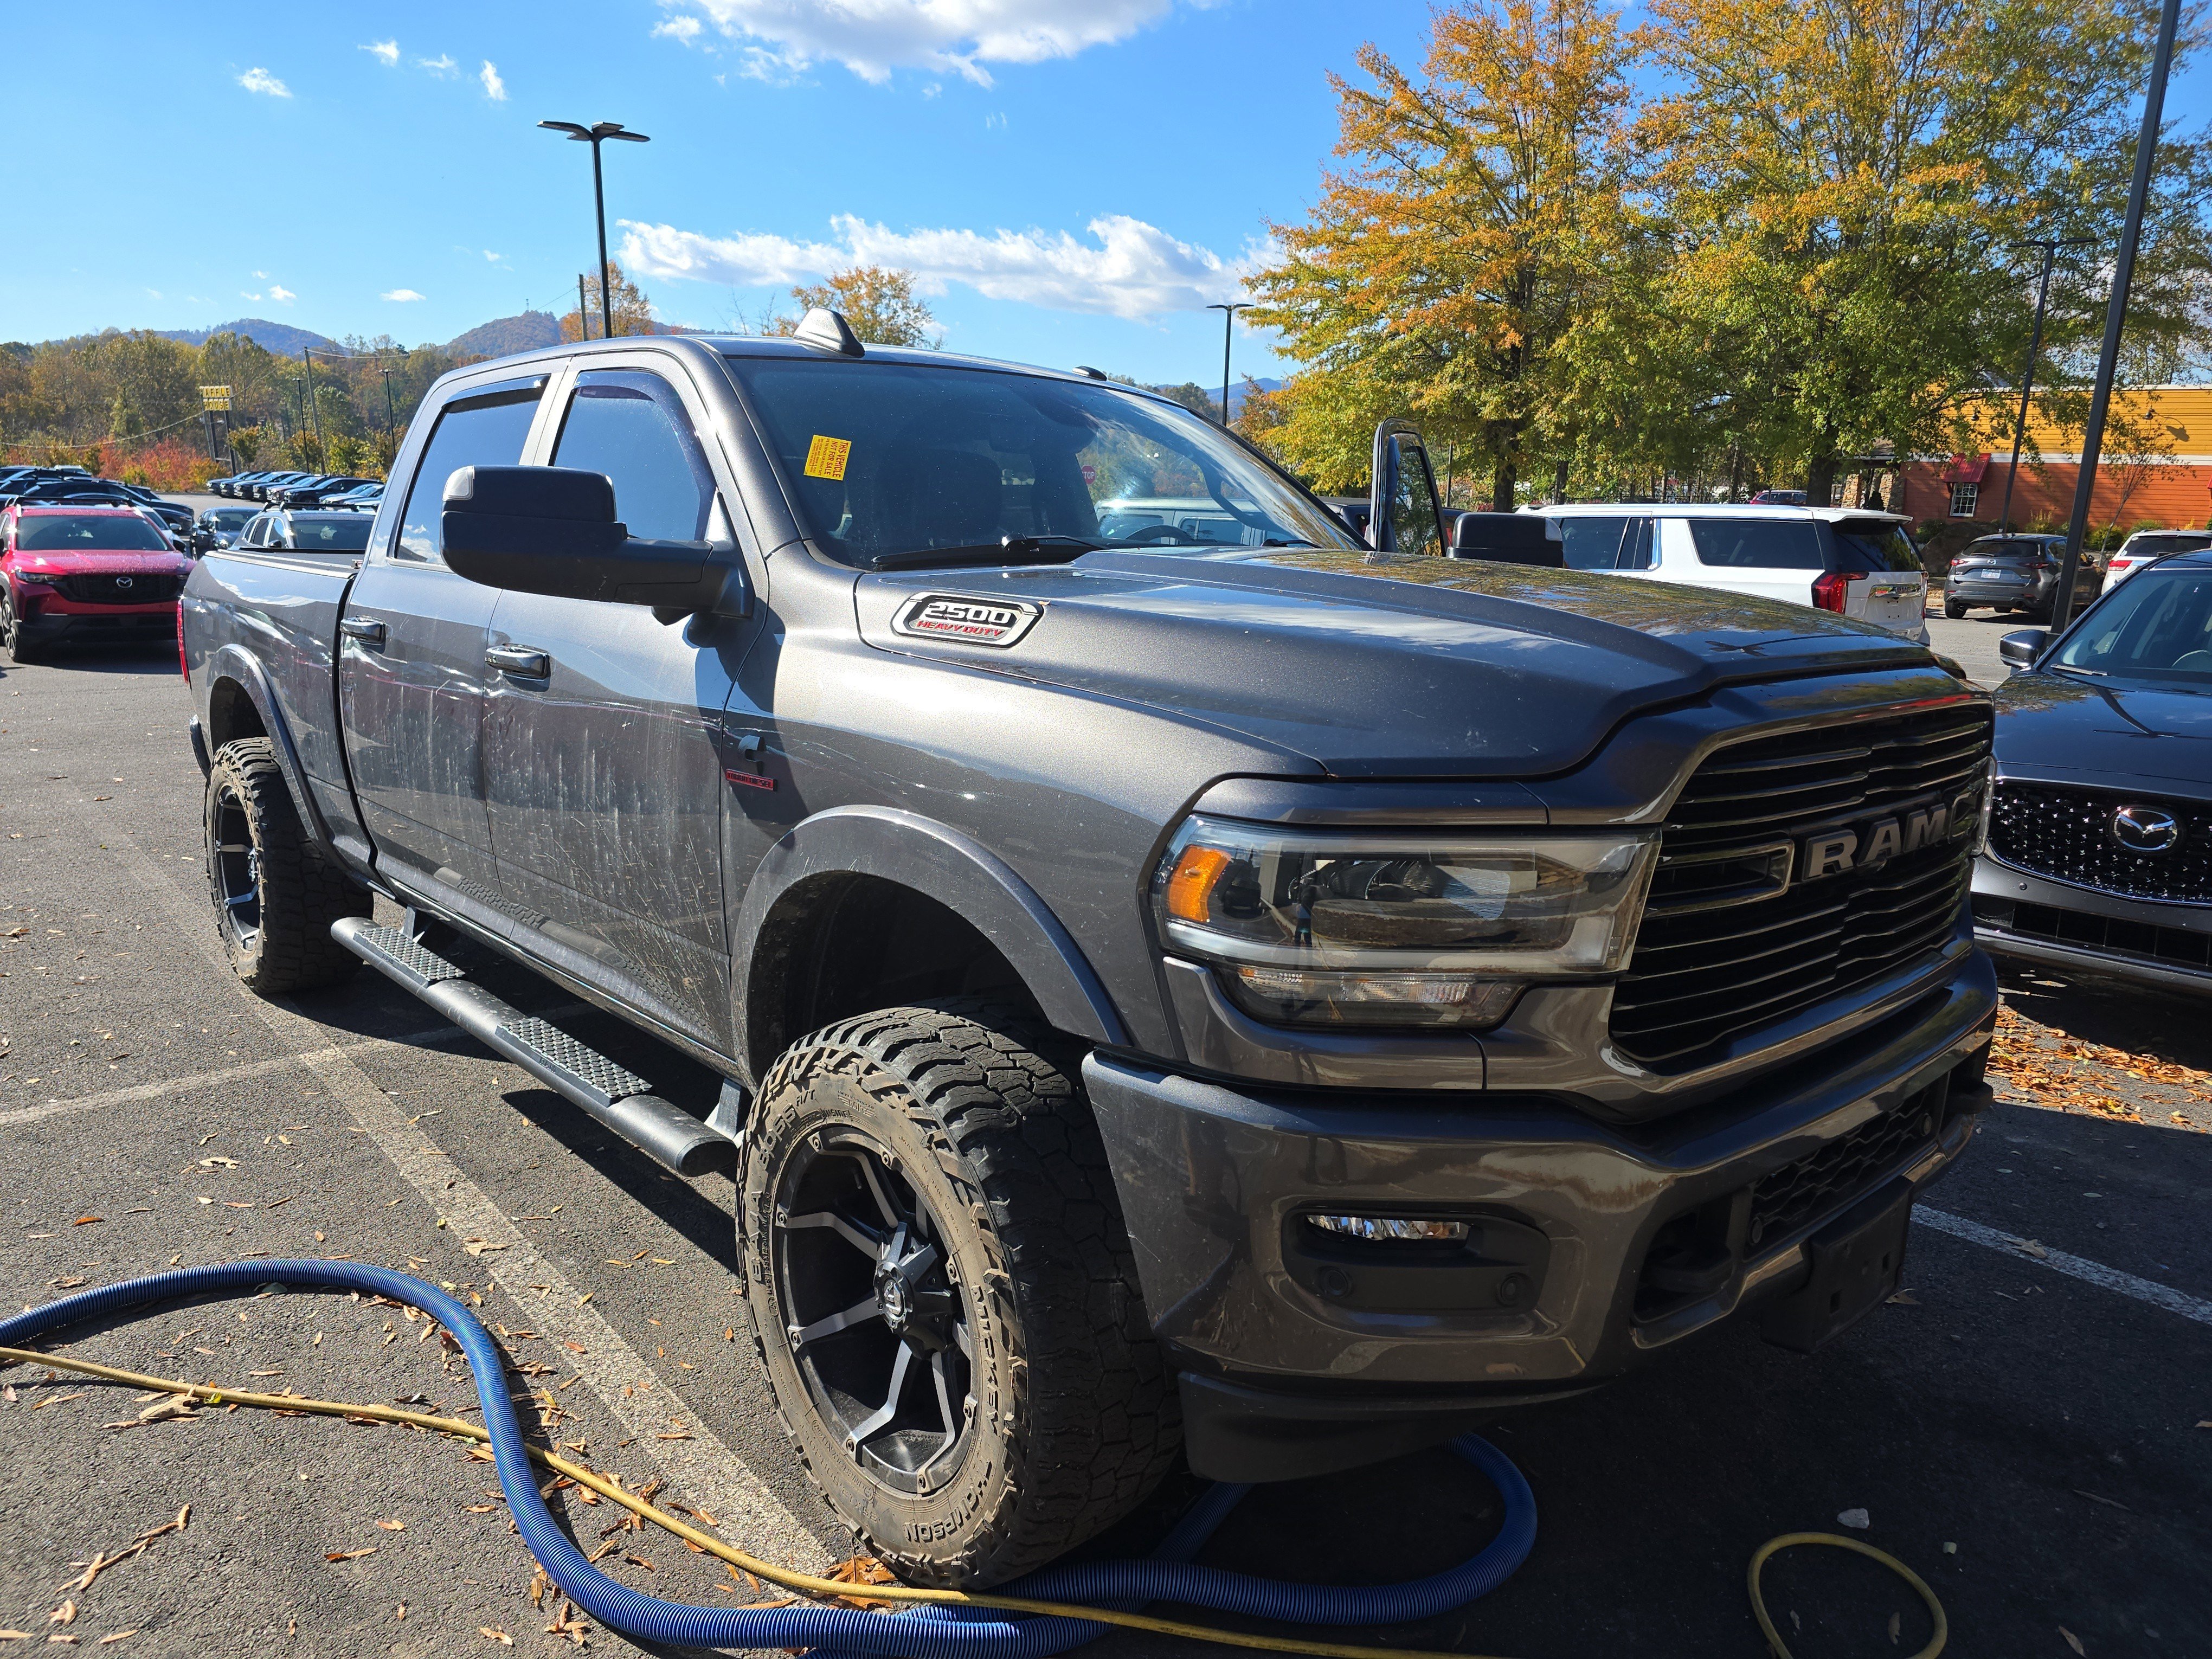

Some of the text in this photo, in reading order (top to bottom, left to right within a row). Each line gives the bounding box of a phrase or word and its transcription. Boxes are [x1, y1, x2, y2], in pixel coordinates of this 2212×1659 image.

[203, 387, 230, 397] AFFLE
[827, 451, 835, 461] FOR
[832, 442, 849, 478] THIS VEHICLE
[824, 462, 833, 475] SALE
[1082, 471, 1095, 479] TOP
[923, 602, 1012, 624] 2500
[917, 620, 1004, 636] HEAVY DUTY
[1803, 803, 1947, 882] RAM
[749, 1190, 763, 1282] BAJA
[758, 1103, 796, 1169] BOSS
[972, 1284, 999, 1436] MICKEY
[902, 1459, 993, 1543] THOMPSON
